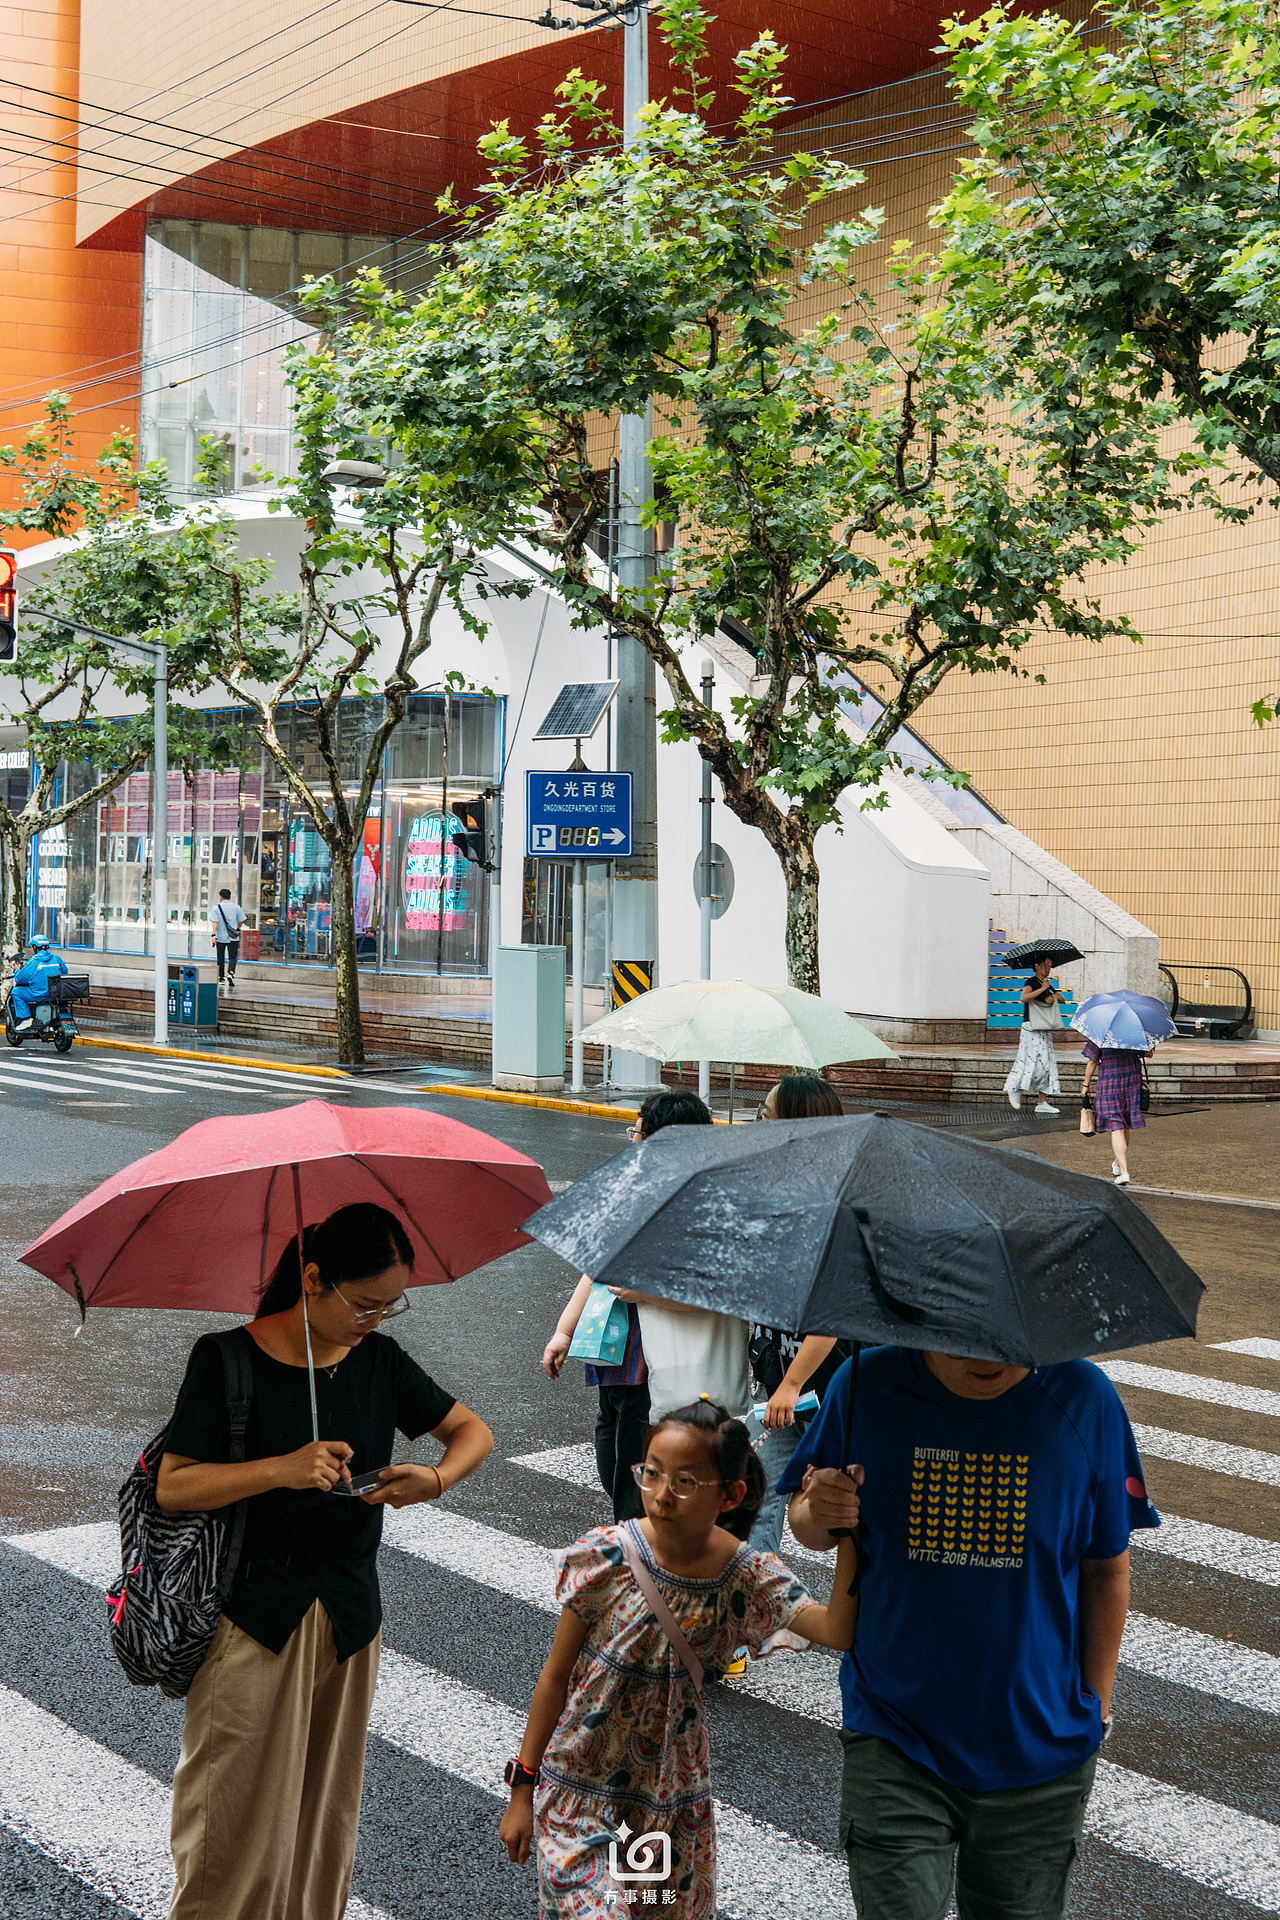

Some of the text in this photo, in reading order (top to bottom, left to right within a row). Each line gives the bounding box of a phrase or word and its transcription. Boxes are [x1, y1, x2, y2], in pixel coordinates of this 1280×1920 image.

[544, 780, 616, 798] 久光百货
[543, 803, 616, 813] ONGOINGDEPARTMENT STORE
[536, 827, 553, 848] P
[39, 840, 67, 856] adidas
[39, 868, 67, 885] SNEAKER
[39, 887, 67, 908] COLLECT
[914, 1446, 960, 1463] BUTTERFLY
[908, 1547, 1023, 1569] WTTC 2018 HALMSTAD
